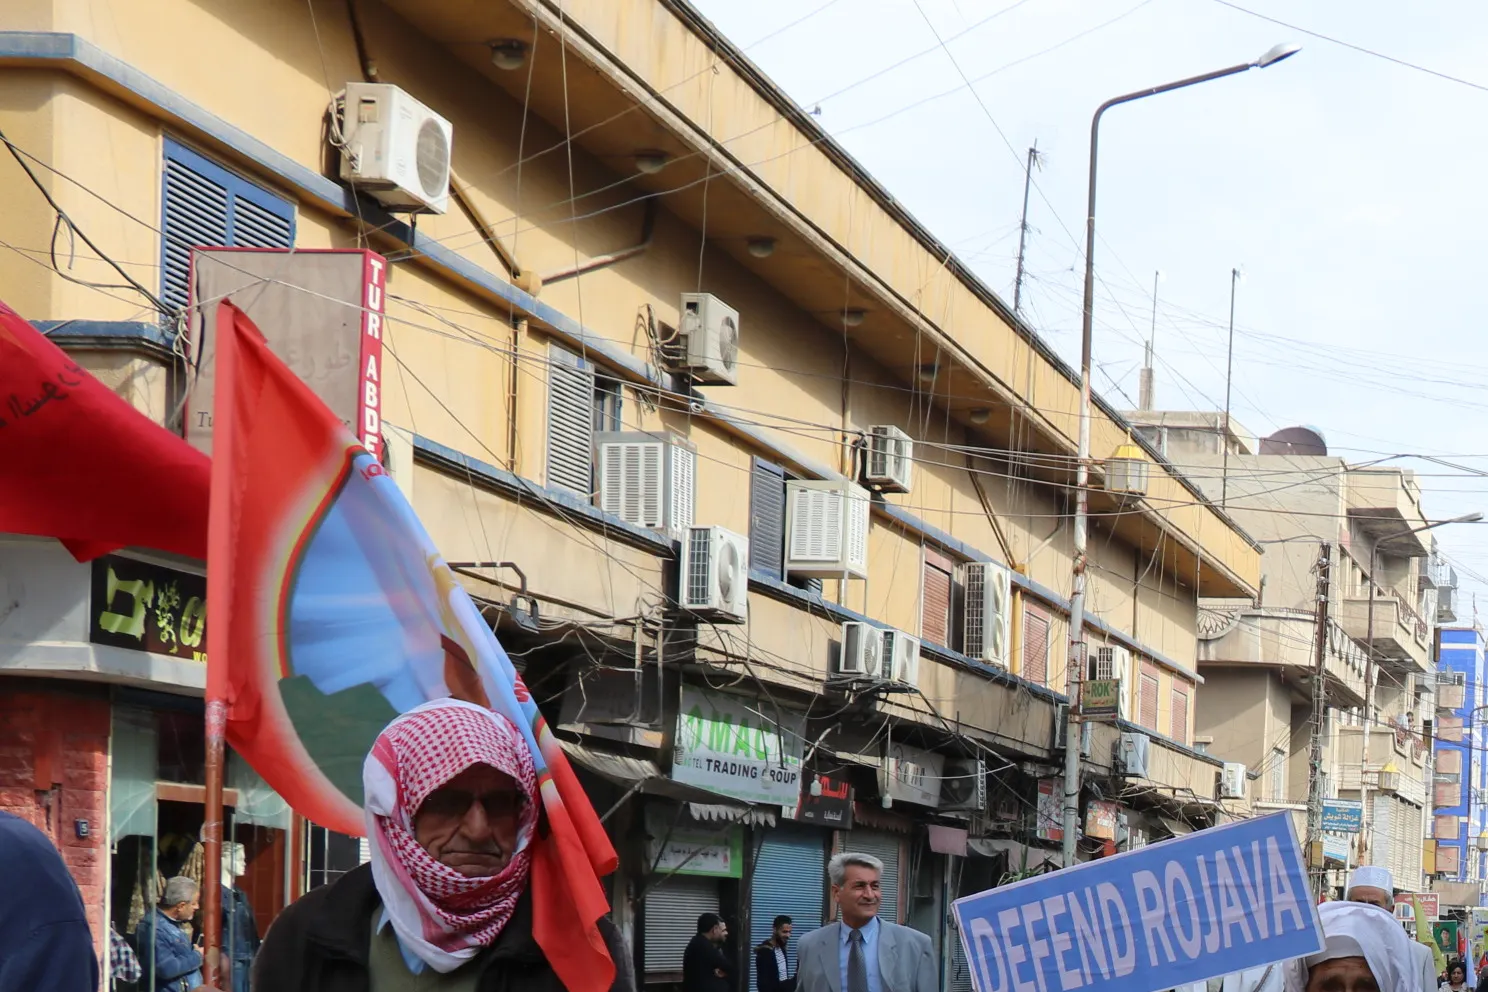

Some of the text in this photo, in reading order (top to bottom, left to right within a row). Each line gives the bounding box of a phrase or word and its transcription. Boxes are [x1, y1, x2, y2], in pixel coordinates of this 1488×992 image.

[1090, 681, 1111, 697] ROK
[706, 758, 757, 779] TRADING
[1132, 835, 1305, 967] ROJAVA
